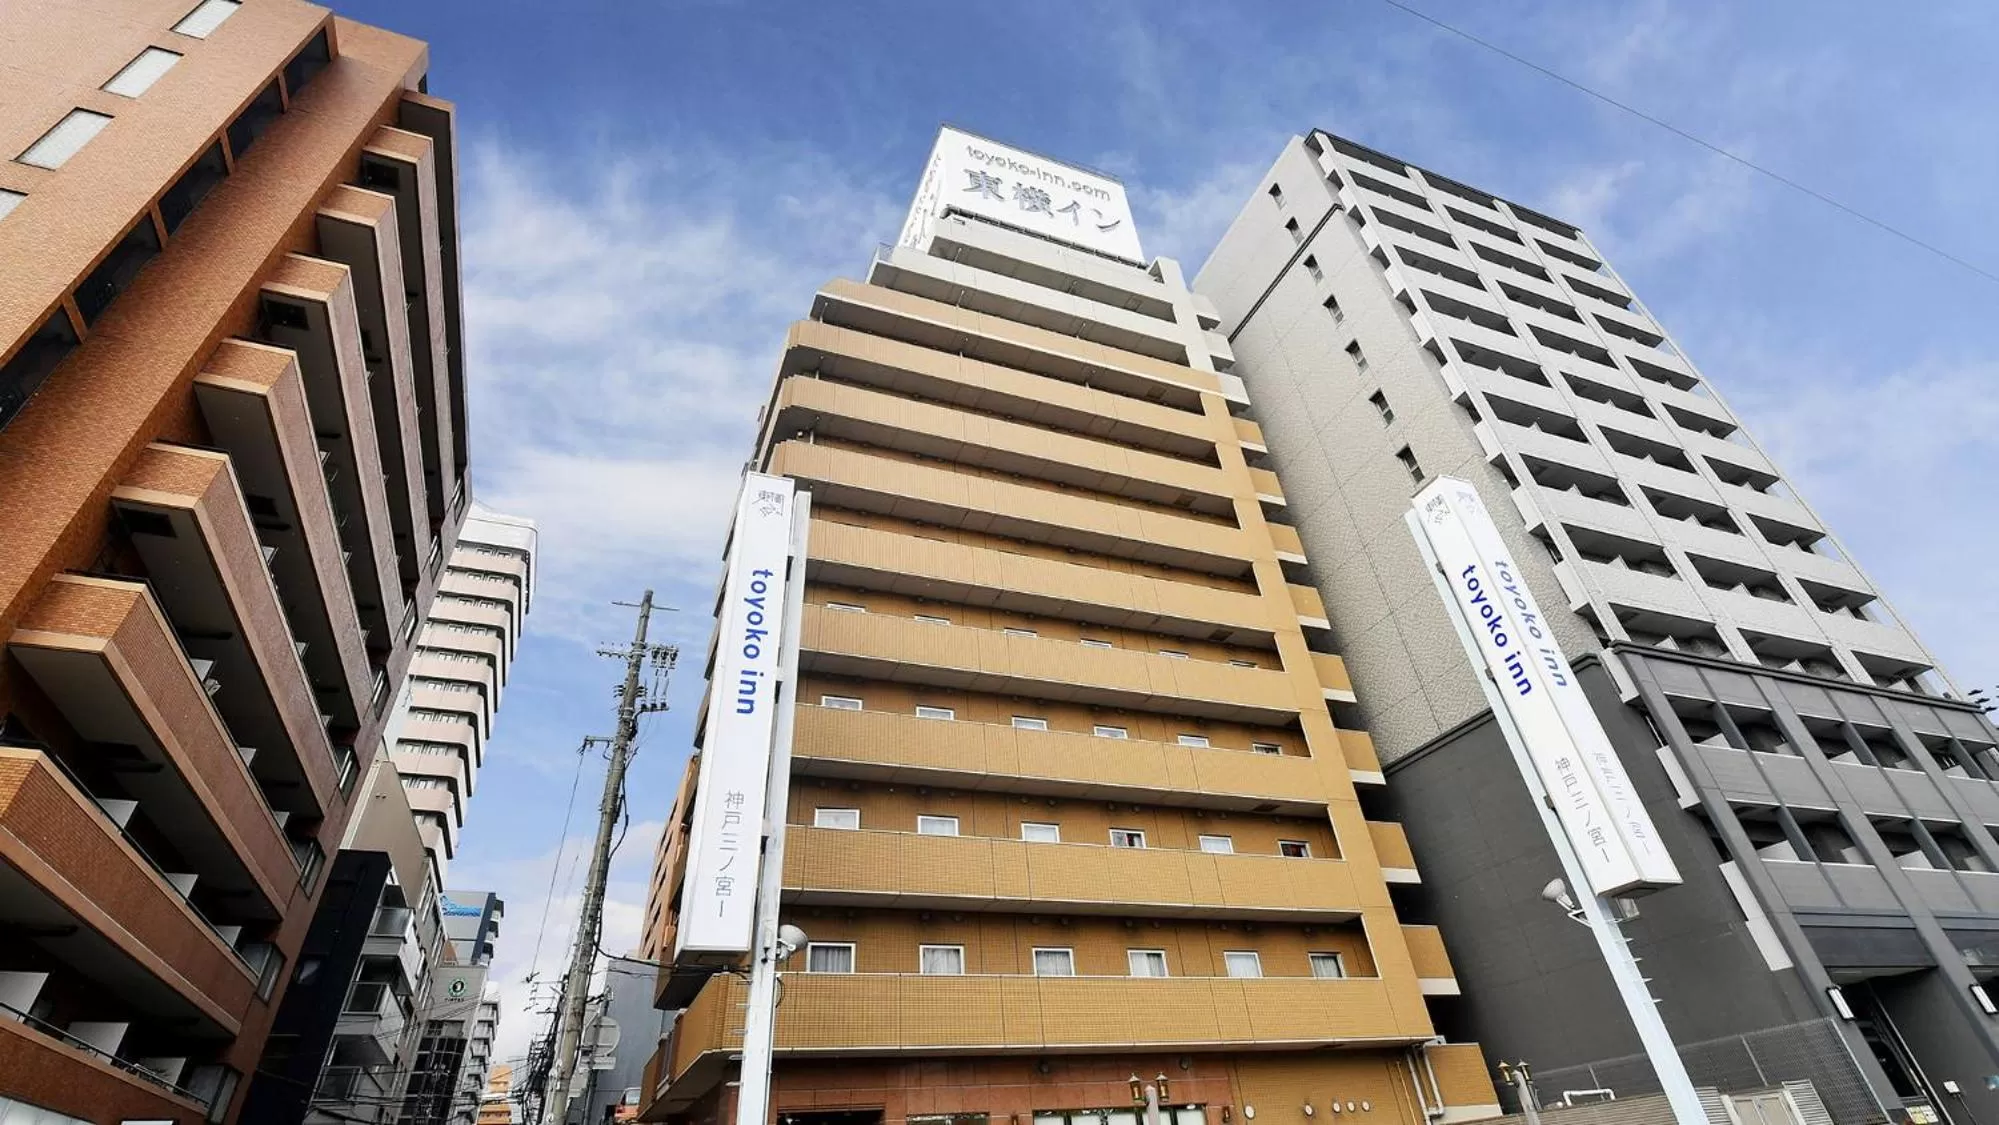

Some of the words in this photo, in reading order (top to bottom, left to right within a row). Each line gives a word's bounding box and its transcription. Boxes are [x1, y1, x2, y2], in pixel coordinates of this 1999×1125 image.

[962, 168, 1121, 233] 東横イン
[966, 145, 1111, 202] toyoko-inn.com
[743, 569, 774, 660] toyoko
[1462, 565, 1508, 648] toyoko
[1504, 651, 1532, 696] inn
[1495, 561, 1543, 640] toyoko
[1540, 648, 1568, 687] inn
[736, 669, 765, 714] inn
